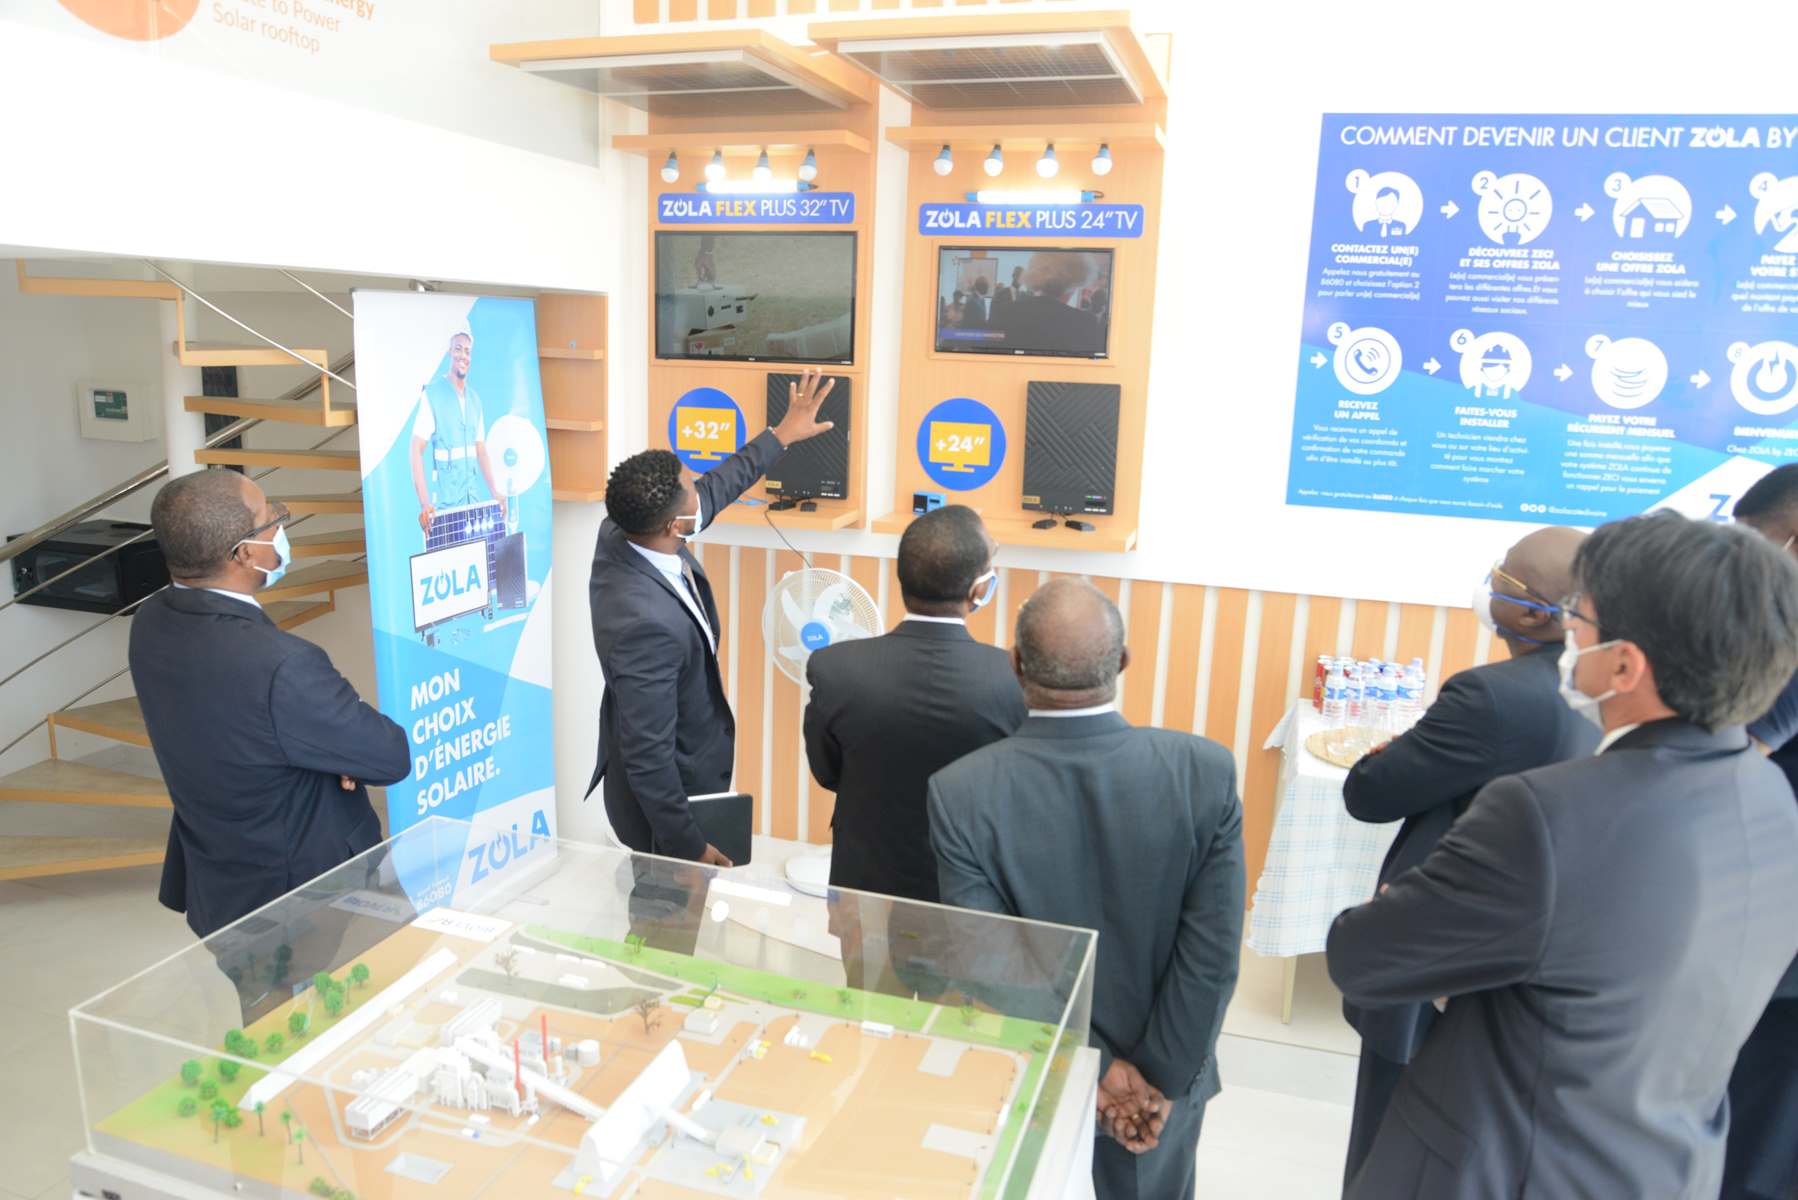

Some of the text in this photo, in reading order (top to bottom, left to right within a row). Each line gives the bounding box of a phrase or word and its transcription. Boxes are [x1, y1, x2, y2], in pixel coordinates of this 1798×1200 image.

[212, 2, 320, 55] Solar rooftop
[1340, 125, 1797, 148] COMMENT DEVENIR UN CLIENT ZOLA BY
[1480, 177, 1489, 190] 2
[1612, 179, 1622, 192] 3
[1757, 180, 1768, 192] 4
[663, 198, 712, 217] ZOLA
[716, 200, 756, 217] FLEX
[761, 199, 796, 217] PLUS
[829, 199, 849, 217] TV
[926, 209, 981, 229] ZOLA
[985, 211, 1032, 229] FLEX
[1036, 211, 1076, 229] PLUS
[1116, 211, 1138, 229] TV
[1331, 243, 1419, 256] CONTACTEZ UN(E)
[1468, 246, 1554, 259] DÉCOUVREZ ZECI
[1335, 255, 1413, 267] COMMERCIAL(E)
[1459, 258, 1560, 270] ET SES OFFRES ZOLA
[1596, 262, 1686, 274] UNE OFFRE ZOLA
[1750, 266, 1787, 277] VOTRE
[1334, 326, 1343, 339] 5
[1456, 333, 1466, 346] 6
[1594, 340, 1604, 353] 7
[1338, 400, 1378, 410] RECEVEZ
[1334, 410, 1380, 421] UN APPEL
[1455, 406, 1517, 418] FAITES-VOUS
[1460, 417, 1509, 428] INSTALLER
[1622, 415, 1657, 426] VOTRE
[420, 564, 481, 606] ZOLA
[410, 668, 461, 712] MON
[412, 697, 477, 746] CHOIX
[415, 714, 512, 782] D'ÉNERGIE
[417, 756, 501, 817] SOLAIRE.
[468, 809, 551, 886] ZOLA
